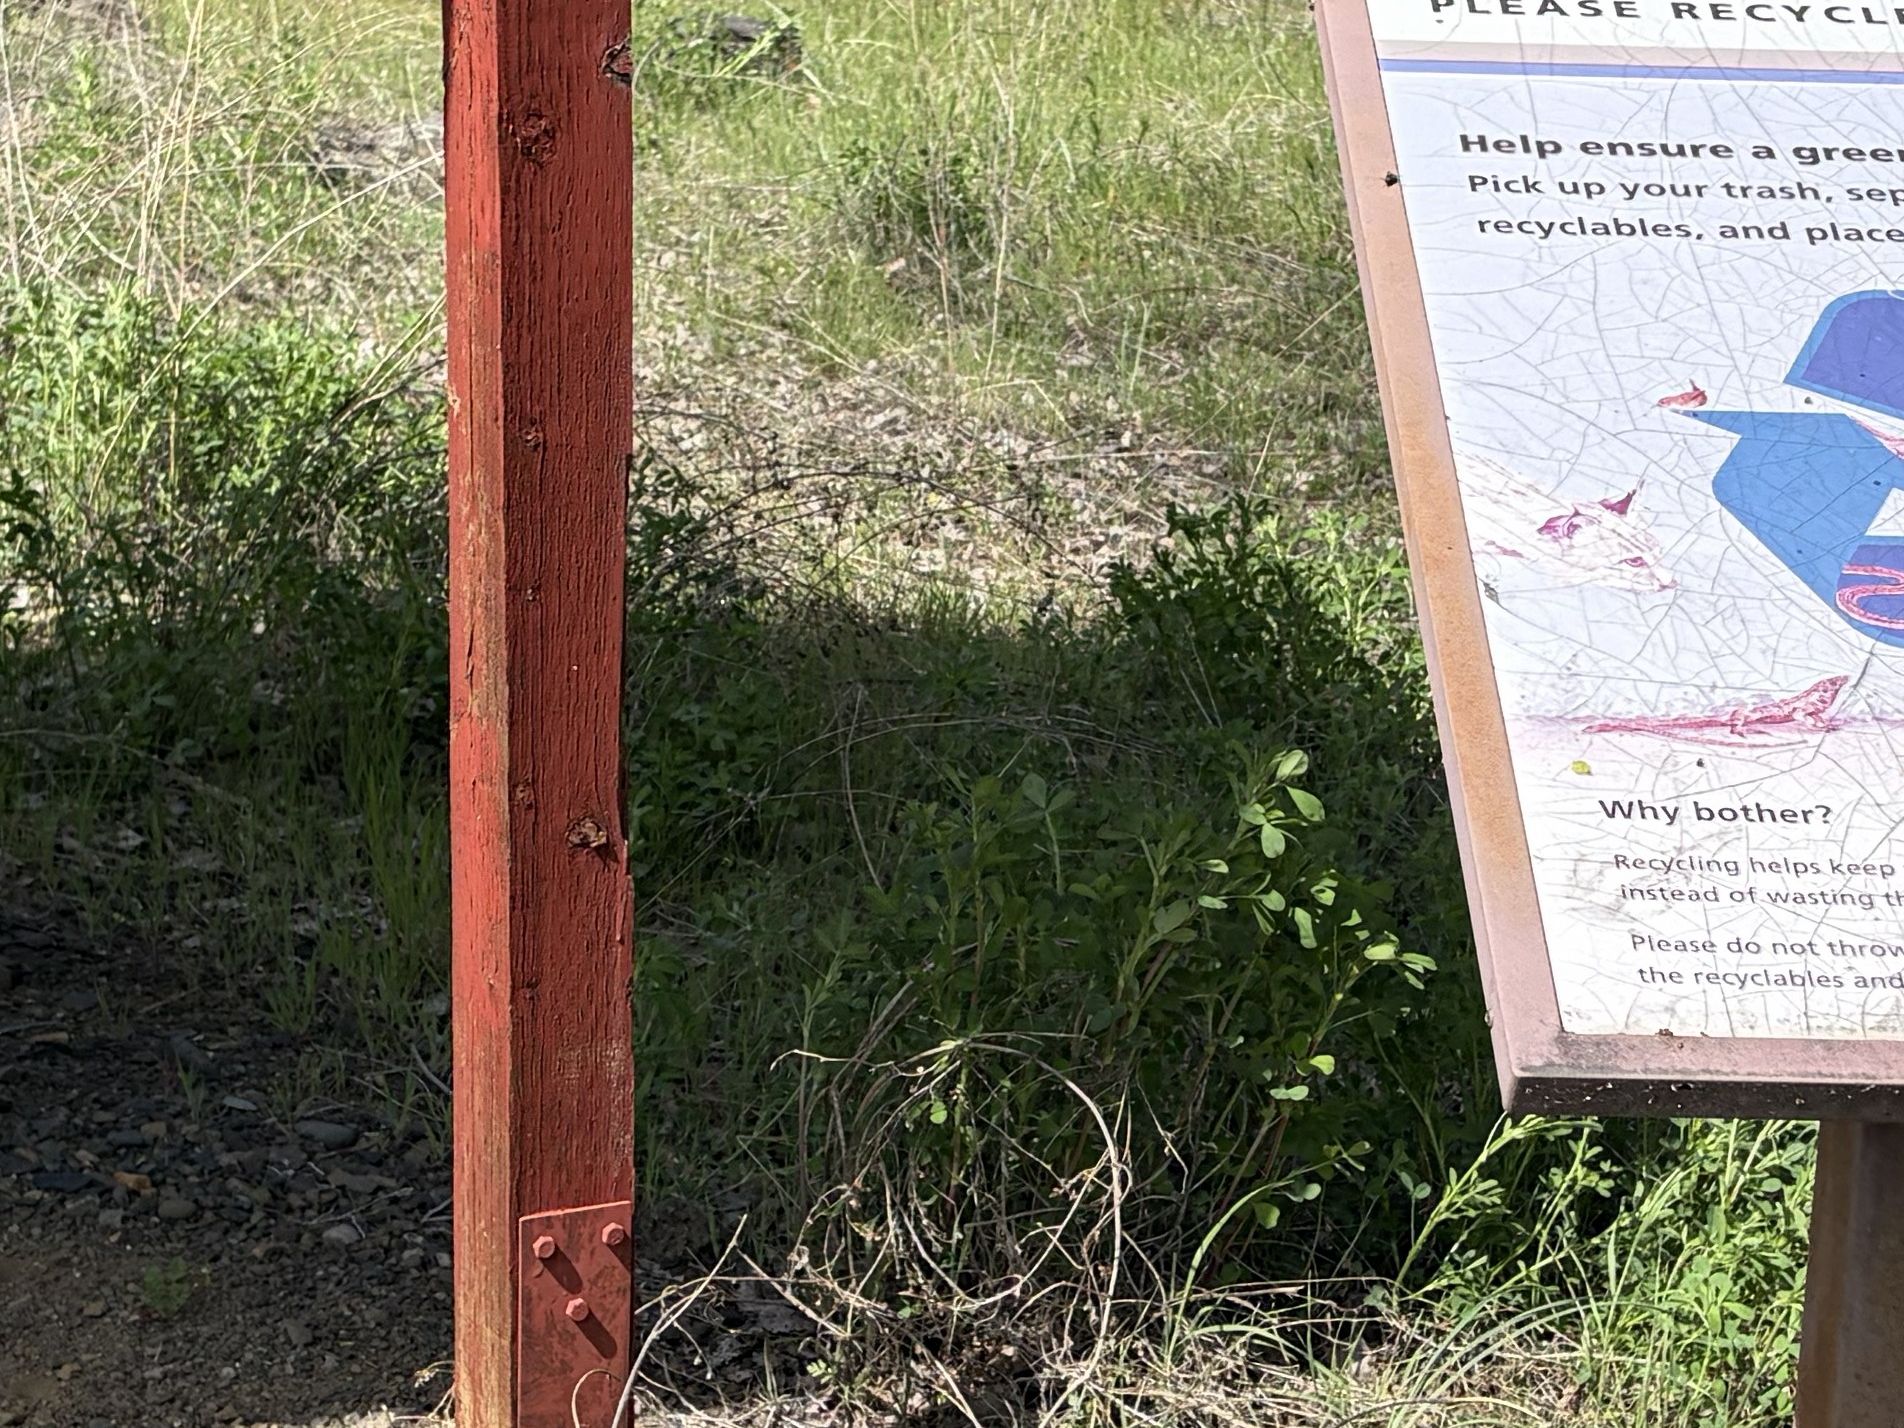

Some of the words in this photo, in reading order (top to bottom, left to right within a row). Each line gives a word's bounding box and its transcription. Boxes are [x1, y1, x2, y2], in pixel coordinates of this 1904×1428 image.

[1459, 134, 1563, 159] Help
[1579, 141, 1734, 159] ensure
[1751, 145, 1776, 160] a
[1468, 174, 1544, 194] Pick
[1558, 181, 1606, 200] up
[1619, 182, 1708, 201] your
[1720, 181, 1833, 203] trash,
[1478, 216, 1704, 241] recyclables,
[1719, 221, 1791, 240] and
[1598, 799, 1679, 826] Why
[1693, 800, 1831, 824] bother?
[1614, 854, 1740, 876] Recycling
[1749, 856, 1821, 878] helps
[1830, 858, 1895, 880] keep
[1621, 885, 1720, 903] instead
[1729, 887, 1757, 904] of
[1767, 890, 1874, 910] wasting
[1631, 935, 1717, 953] Please
[1727, 937, 1761, 955] do
[1772, 940, 1820, 957] not
[1638, 966, 1683, 985] the
[1694, 969, 1844, 989] recyclables
